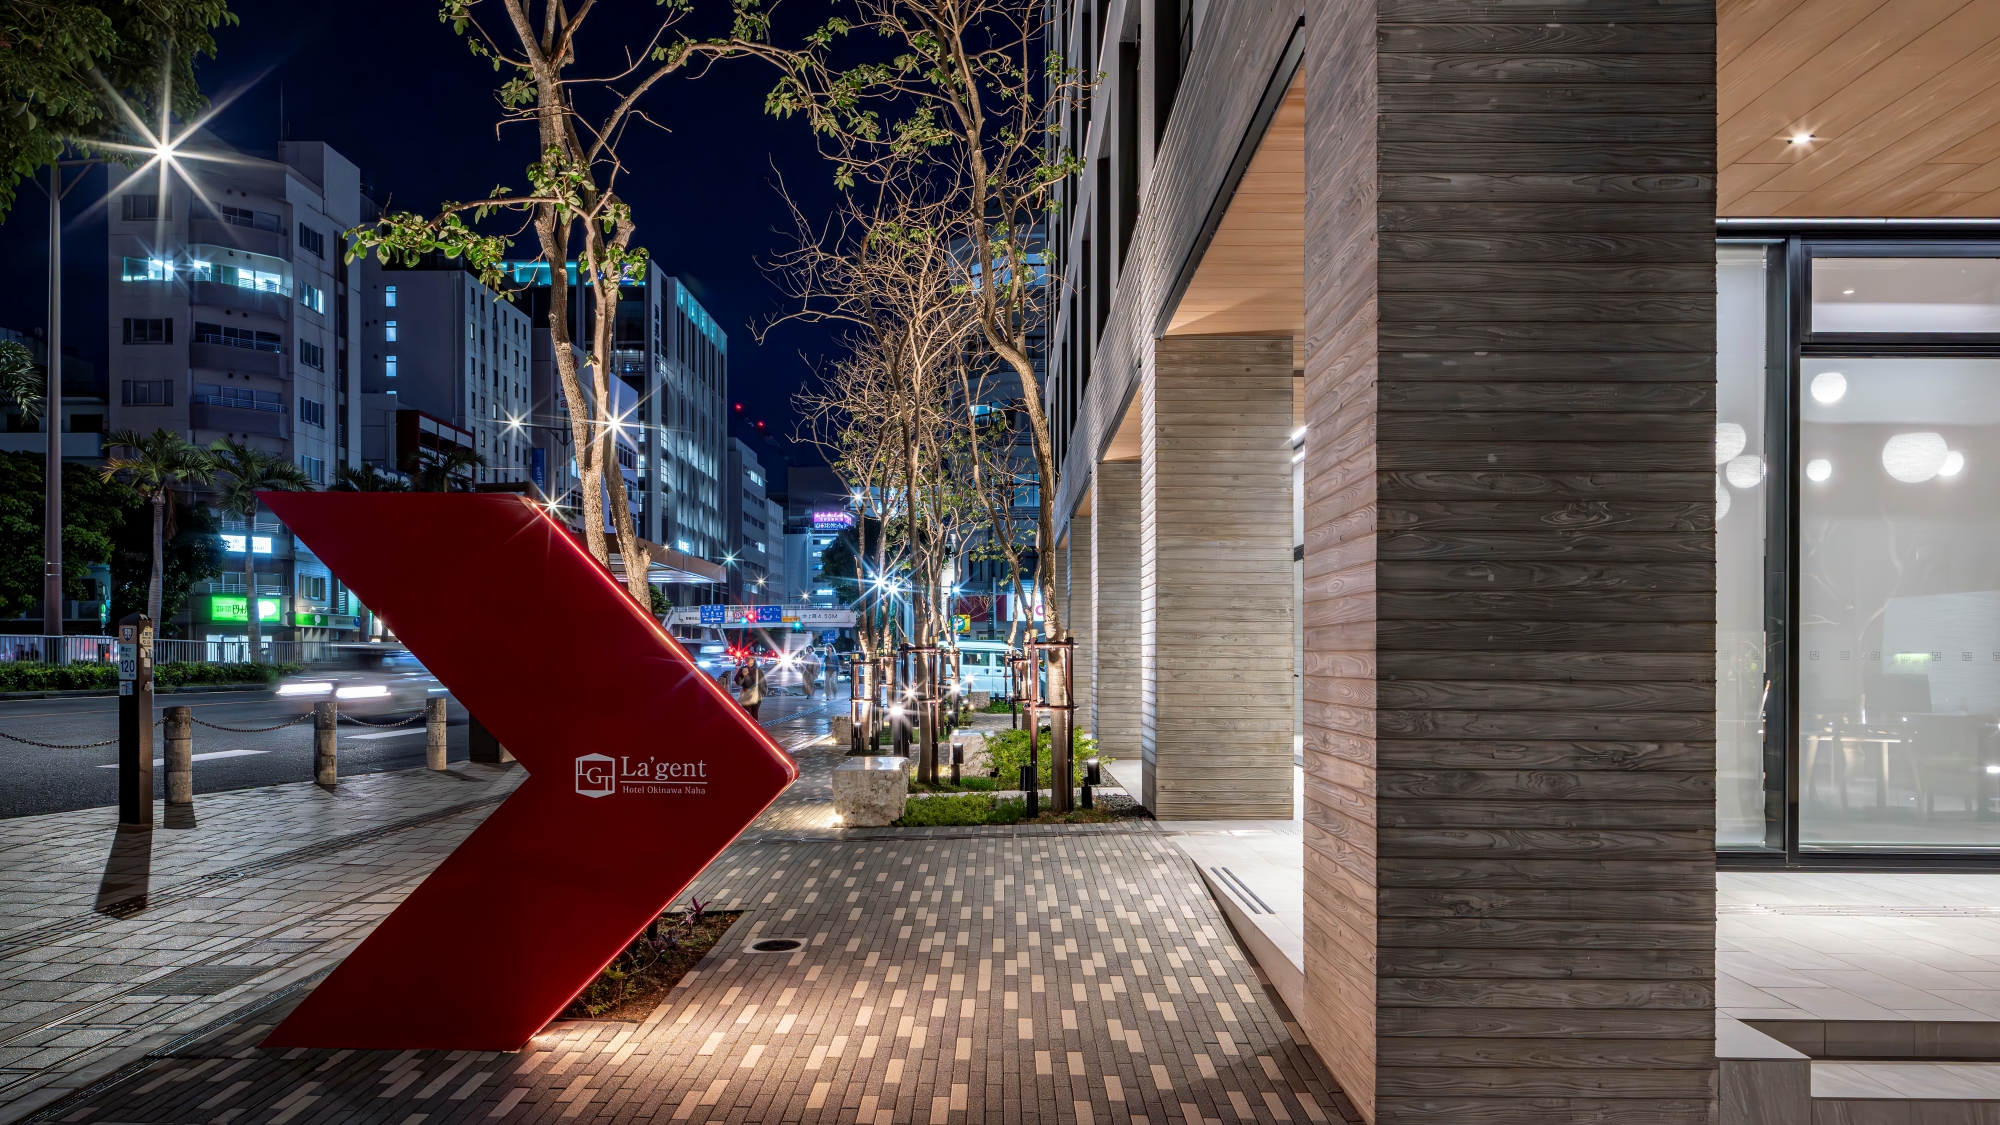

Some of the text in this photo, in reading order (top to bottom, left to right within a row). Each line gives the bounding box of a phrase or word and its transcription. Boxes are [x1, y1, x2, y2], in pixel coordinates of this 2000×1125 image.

[121, 660, 135, 673] 120
[622, 785, 706, 795] Hotel Okinawa Naha
